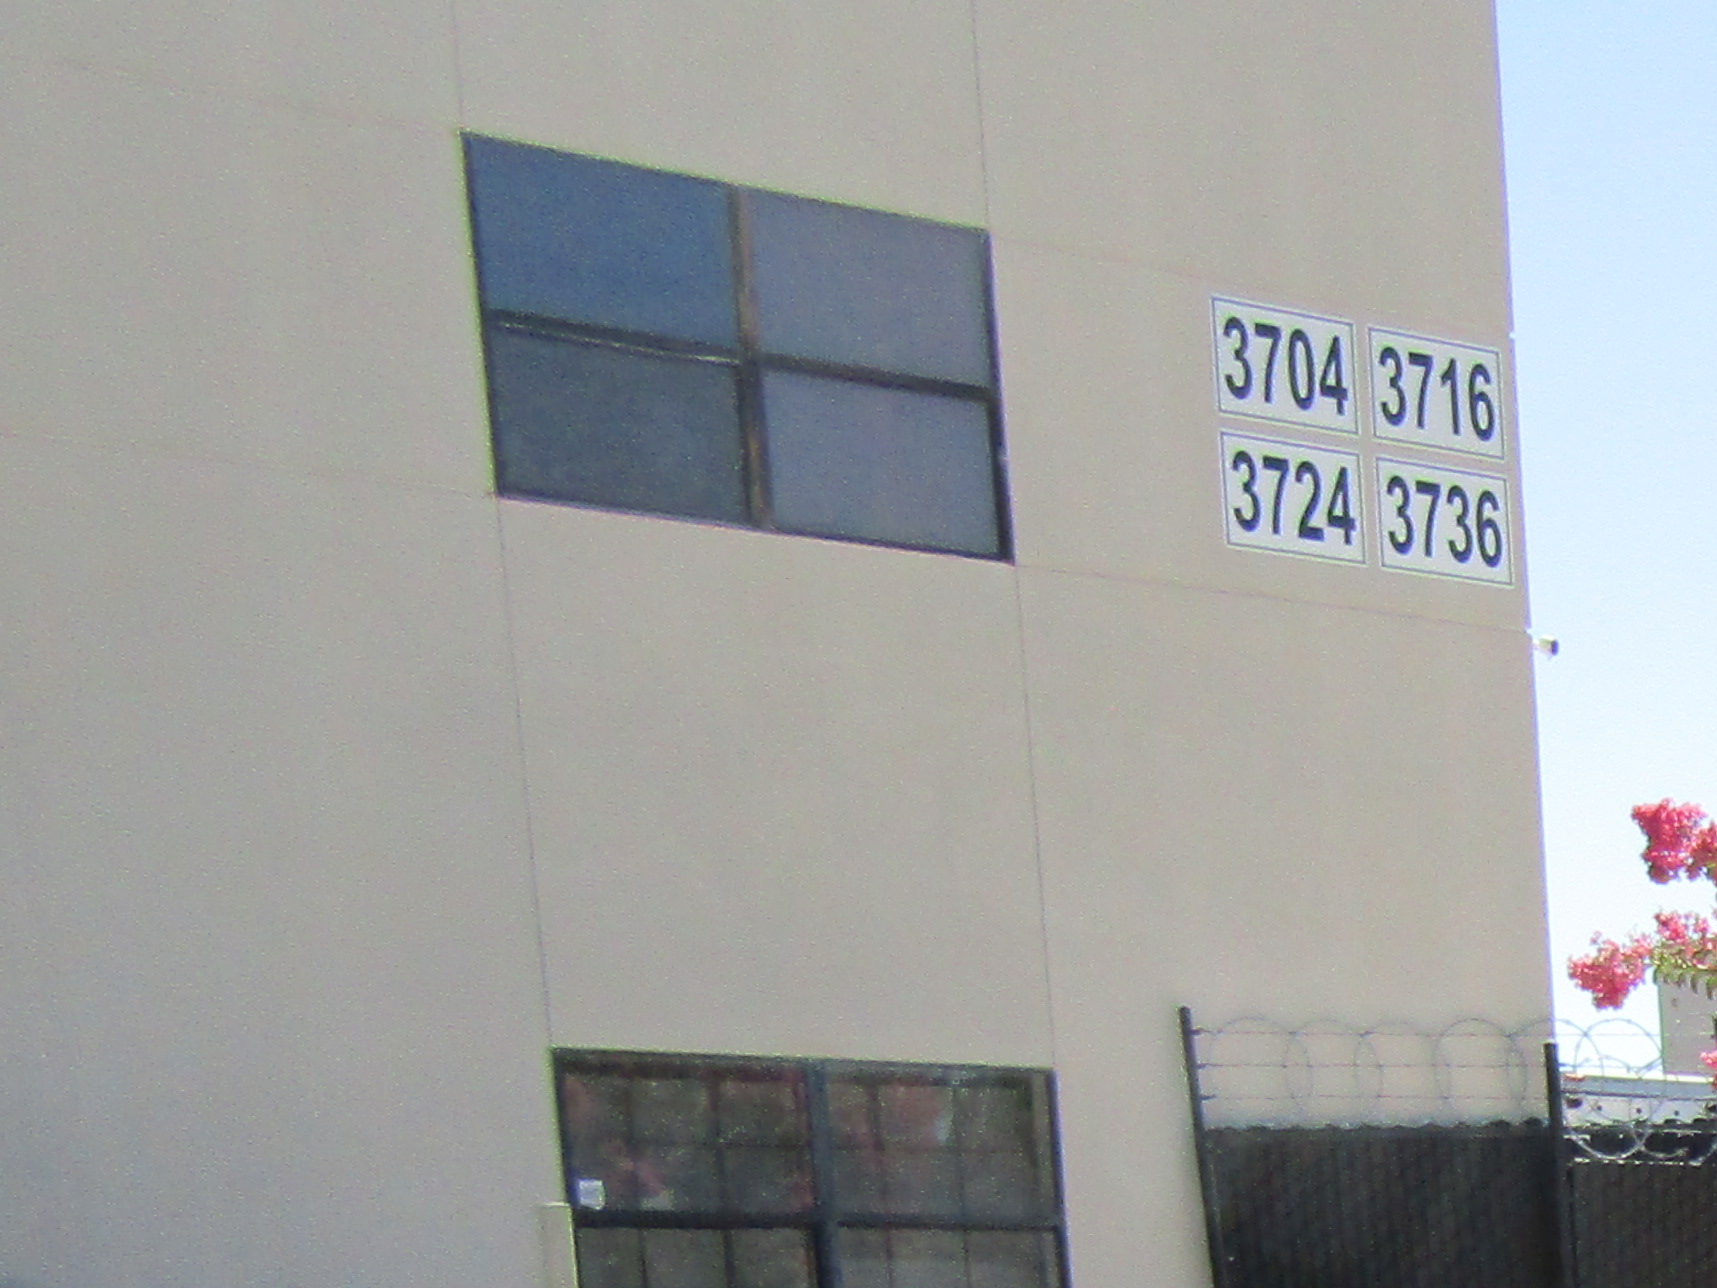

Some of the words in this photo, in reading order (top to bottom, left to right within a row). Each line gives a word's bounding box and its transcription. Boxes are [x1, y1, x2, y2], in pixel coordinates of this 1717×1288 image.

[1223, 317, 1349, 416] 3704
[1379, 346, 1496, 442] 3716
[1232, 450, 1357, 546] 3724
[1386, 475, 1503, 568] 3736
